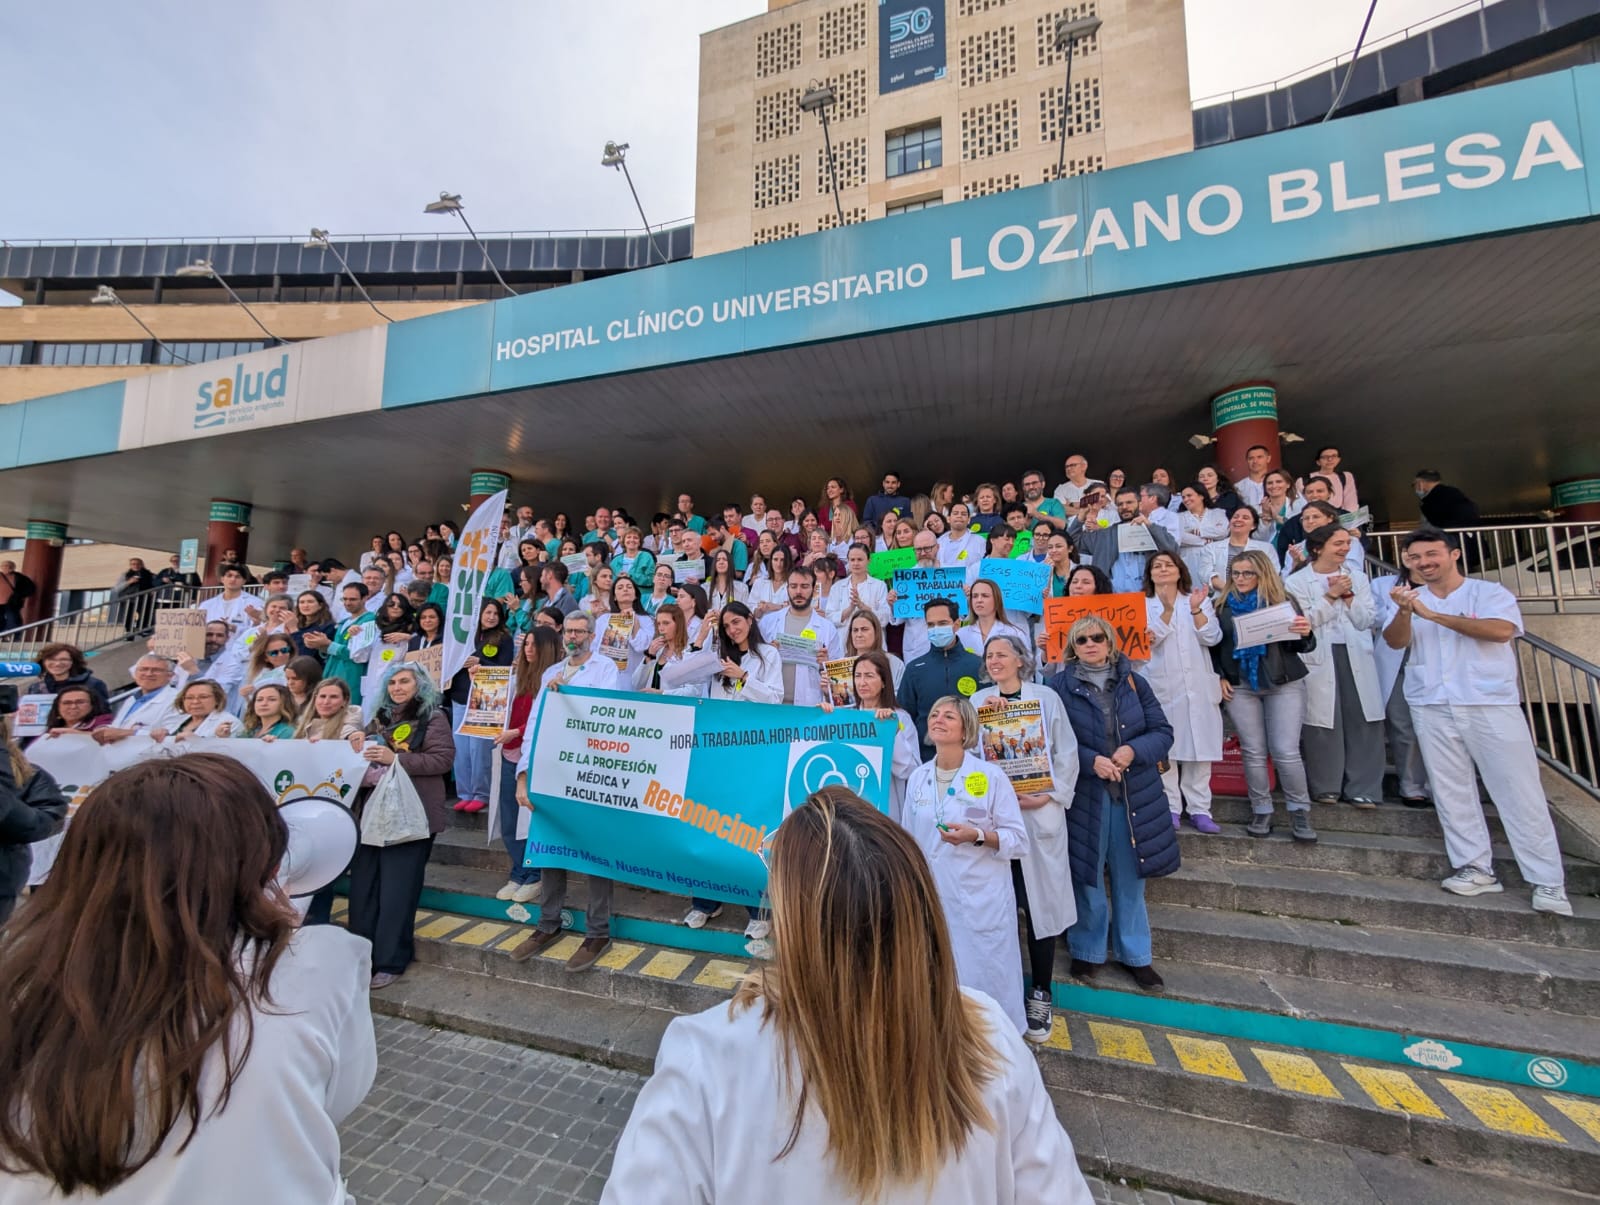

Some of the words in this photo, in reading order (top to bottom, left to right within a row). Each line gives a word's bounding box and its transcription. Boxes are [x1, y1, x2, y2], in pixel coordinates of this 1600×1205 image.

[890, 7, 931, 43] 50
[496, 326, 599, 361] HOSPITAL
[606, 306, 704, 342] CLÍNICO
[712, 262, 929, 324] UNIVERSITARIO
[949, 184, 1243, 280] LOZANO
[1267, 120, 1584, 224] BLESA
[196, 354, 289, 411] salud
[894, 570, 928, 581] HORA
[916, 580, 964, 591] TRABAJADA
[1049, 603, 1136, 624] ESTATUTO
[1117, 625, 1149, 657] YA!
[6, 663, 33, 674] tve
[590, 705, 615, 718] POR
[618, 706, 636, 720] UN
[566, 718, 615, 735] ESTATUTO
[618, 725, 663, 740] MARCO
[669, 733, 699, 750] HORA
[803, 721, 877, 741] COMPUTADA
[587, 738, 630, 753] PROPIO
[559, 750, 574, 763] DE
[576, 754, 590, 766] LA
[592, 756, 657, 775] PROFESIÓN
[576, 770, 618, 788] MÉDICA
[622, 778, 630, 790] Y
[565, 786, 639, 810] FACULTATIVA
[643, 779, 768, 855] Reconocimi
[529, 841, 579, 859] Nuestra
[616, 860, 664, 880] Nuestra
